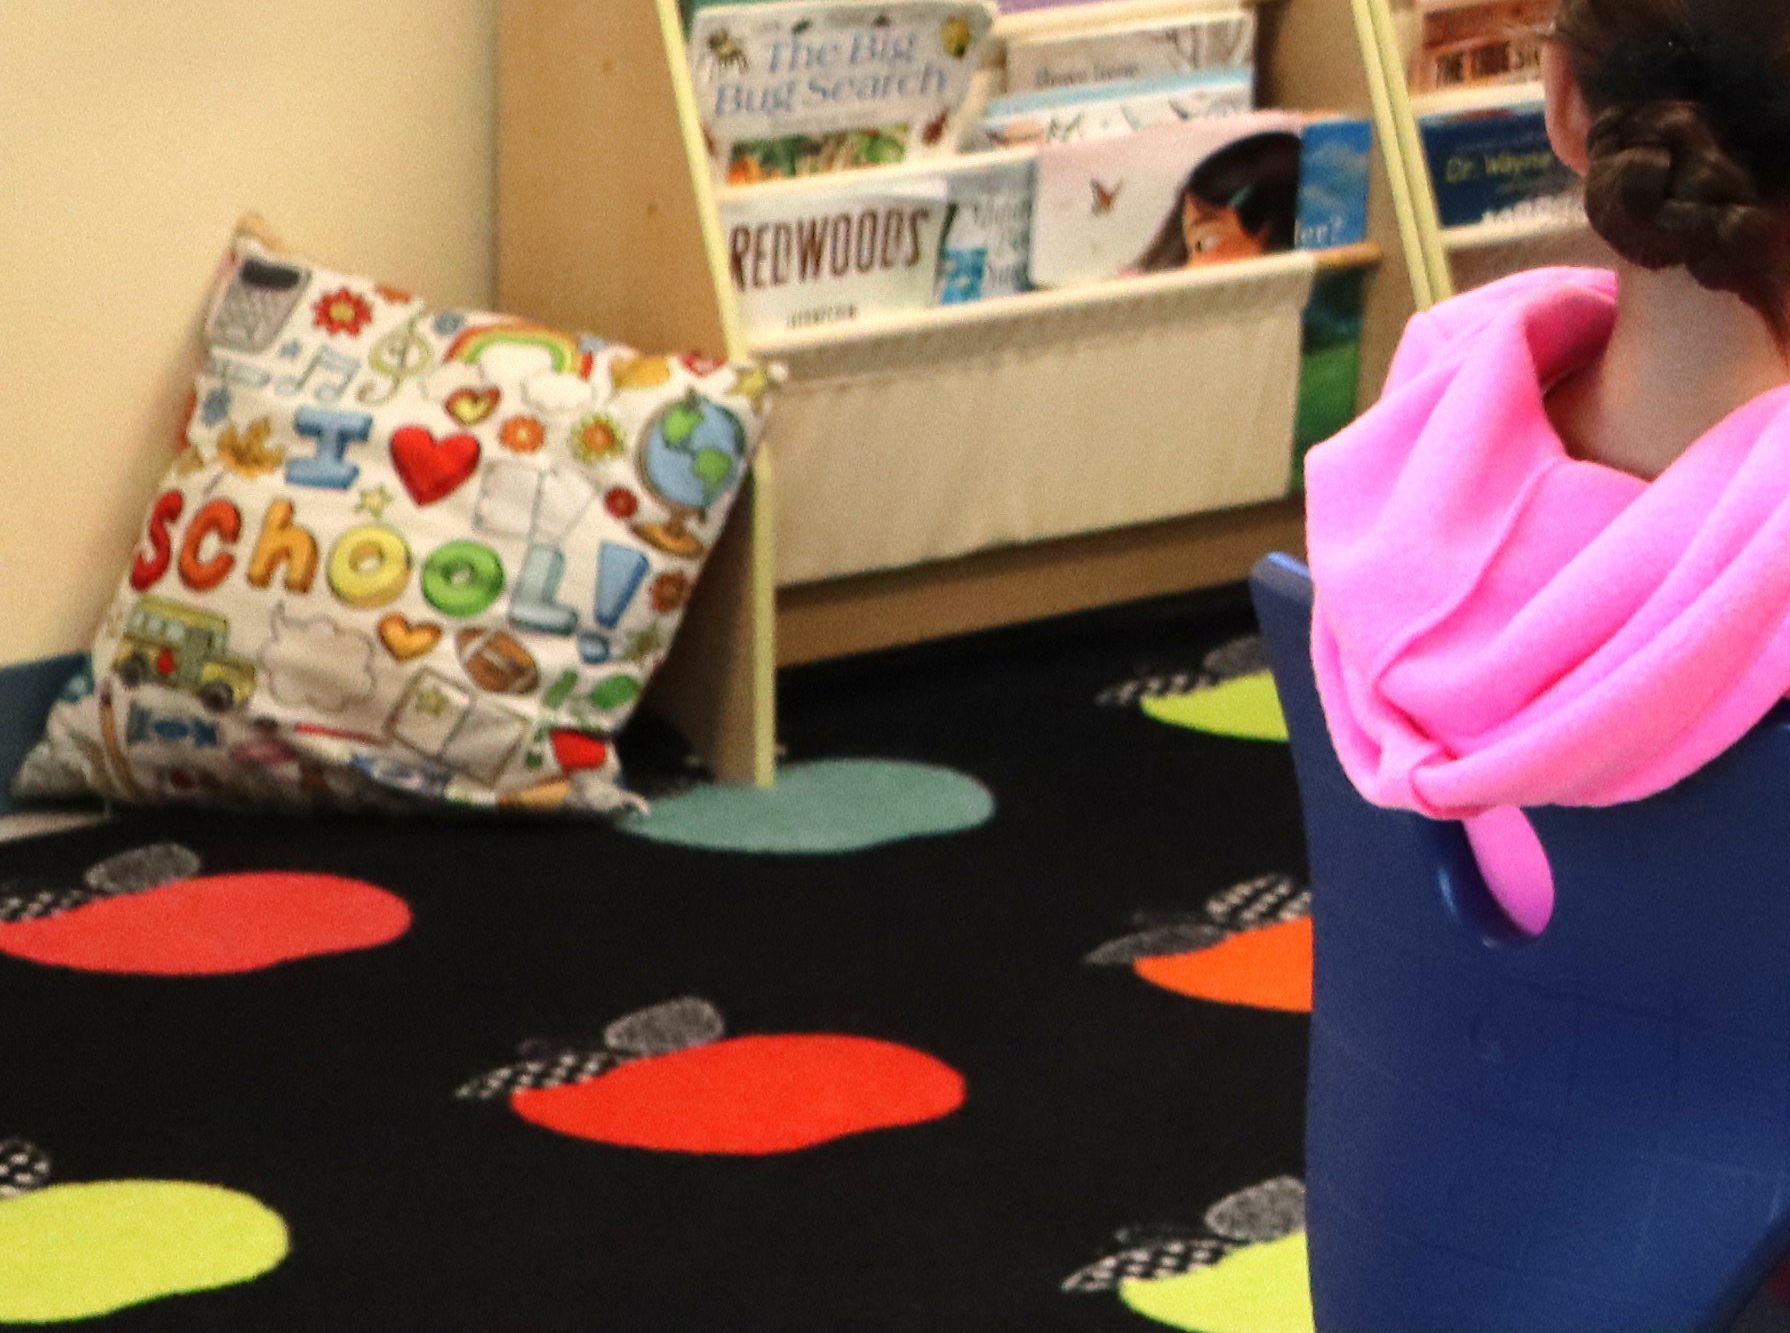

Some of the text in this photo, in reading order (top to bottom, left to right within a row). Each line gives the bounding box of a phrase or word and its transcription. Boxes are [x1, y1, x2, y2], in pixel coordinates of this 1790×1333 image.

[714, 60, 949, 117] Bug Search
[769, 33, 842, 73] The
[728, 206, 931, 293] REDWOODS
[284, 407, 375, 492] I
